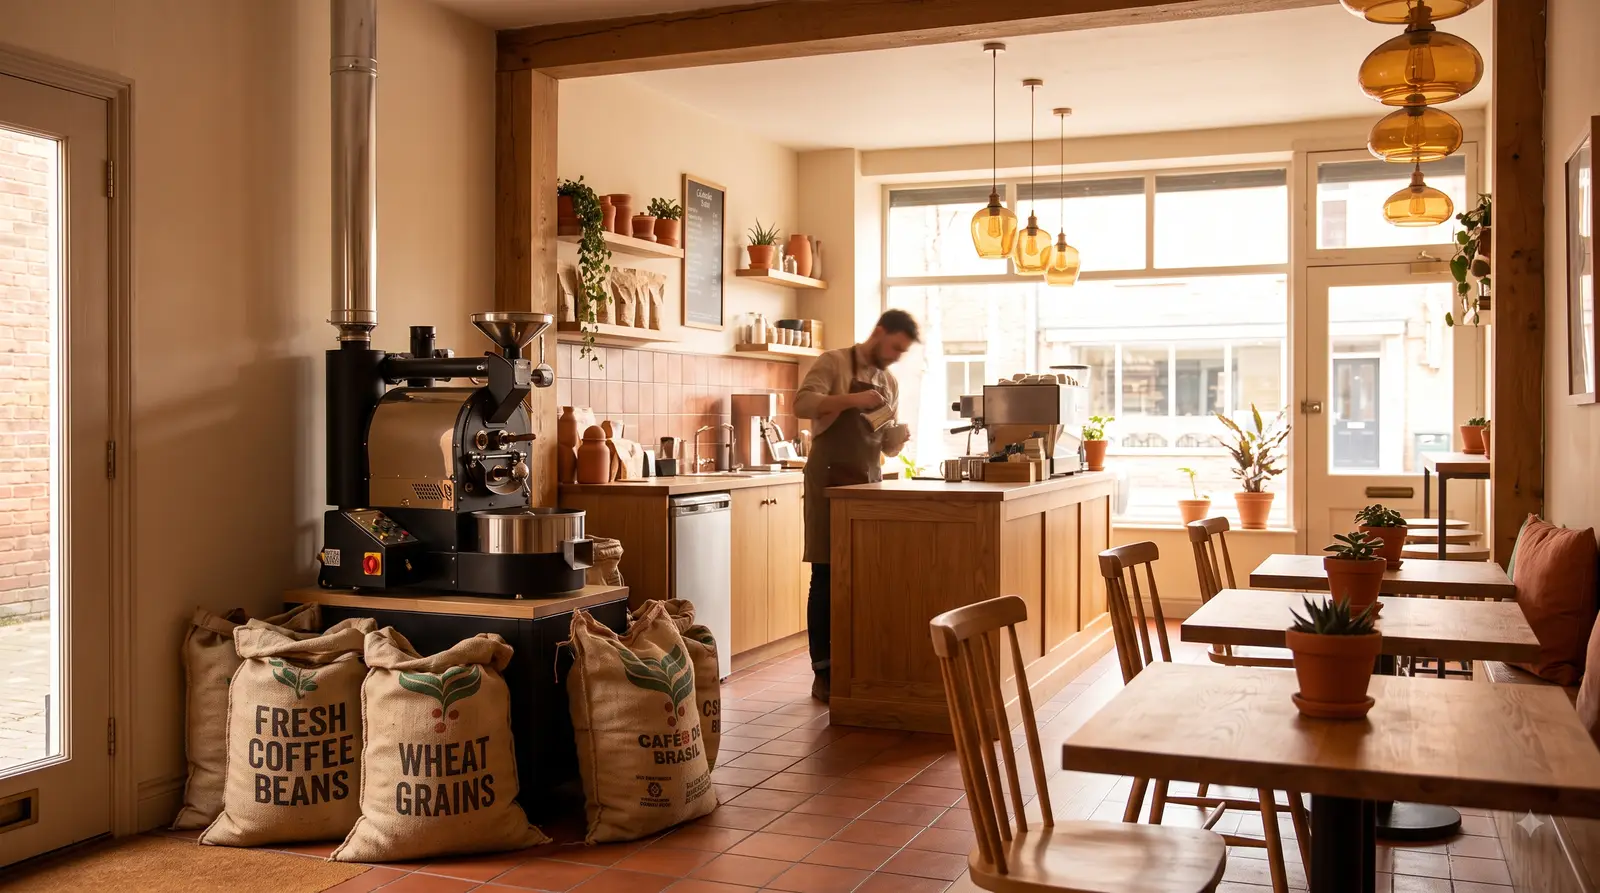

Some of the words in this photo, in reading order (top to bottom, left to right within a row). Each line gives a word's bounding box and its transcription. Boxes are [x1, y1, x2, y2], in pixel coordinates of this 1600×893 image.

[256, 703, 346, 737] FRESH
[638, 729, 682, 748] CAFÉ
[691, 724, 701, 740] DE
[249, 735, 354, 772] COFFEE
[399, 735, 490, 777] WHEAT
[653, 743, 700, 765] BRASIL
[254, 770, 349, 806] BEANS
[395, 773, 495, 817] GRAINS
